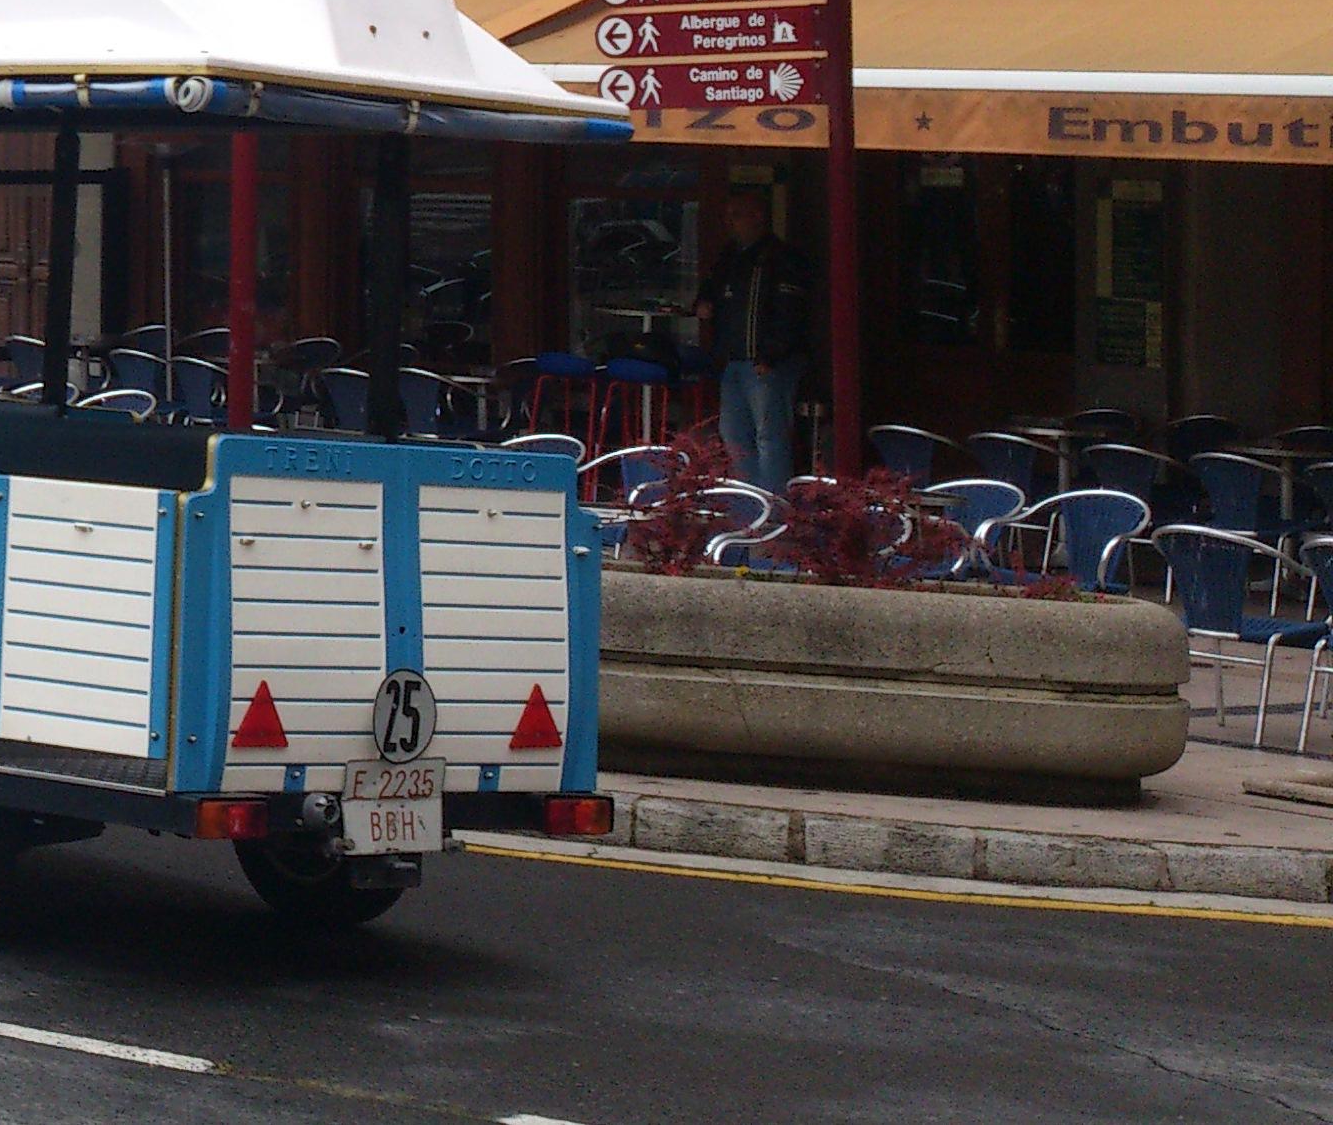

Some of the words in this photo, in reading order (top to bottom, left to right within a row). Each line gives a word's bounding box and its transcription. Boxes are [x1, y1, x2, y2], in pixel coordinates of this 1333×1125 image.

[680, 15, 740, 31] Albergue
[748, 13, 765, 27] de
[693, 33, 766, 50] Peregrinos
[689, 67, 738, 83] Camino
[746, 65, 763, 80] de
[705, 86, 764, 103] Santiago
[1047, 106, 1333, 149] Embut
[451, 456, 536, 482] DOTTO
[383, 679, 422, 753] 25
[378, 769, 434, 799] 2235
